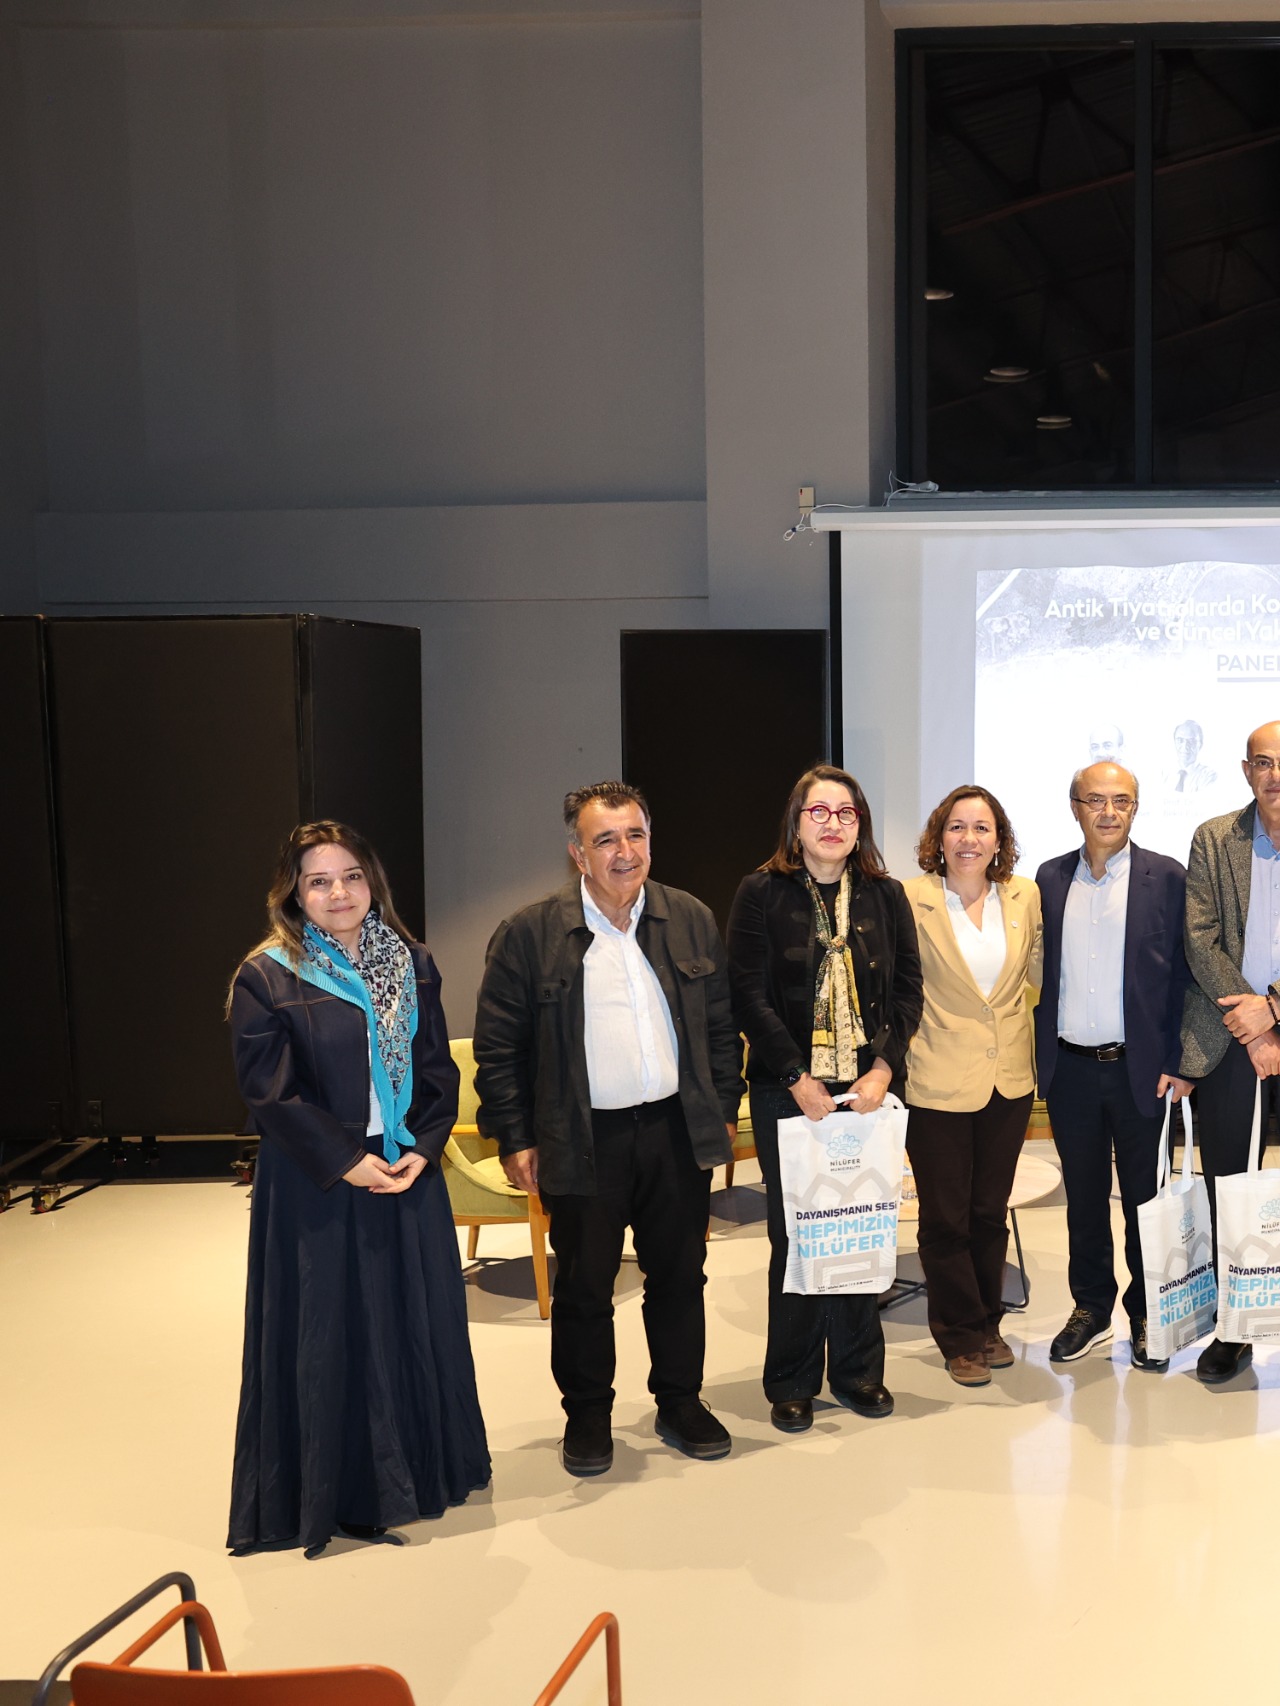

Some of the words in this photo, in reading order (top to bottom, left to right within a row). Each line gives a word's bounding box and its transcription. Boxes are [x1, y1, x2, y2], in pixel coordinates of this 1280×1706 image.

[1044, 598, 1104, 618] Antik
[1108, 595, 1245, 622] Tiyatrolarda
[1135, 627, 1160, 641] ve
[1165, 621, 1241, 641] Güncel
[796, 1204, 873, 1220] DAYANIŞMANIN
[1159, 1263, 1207, 1293] DAYANIŞMANIN
